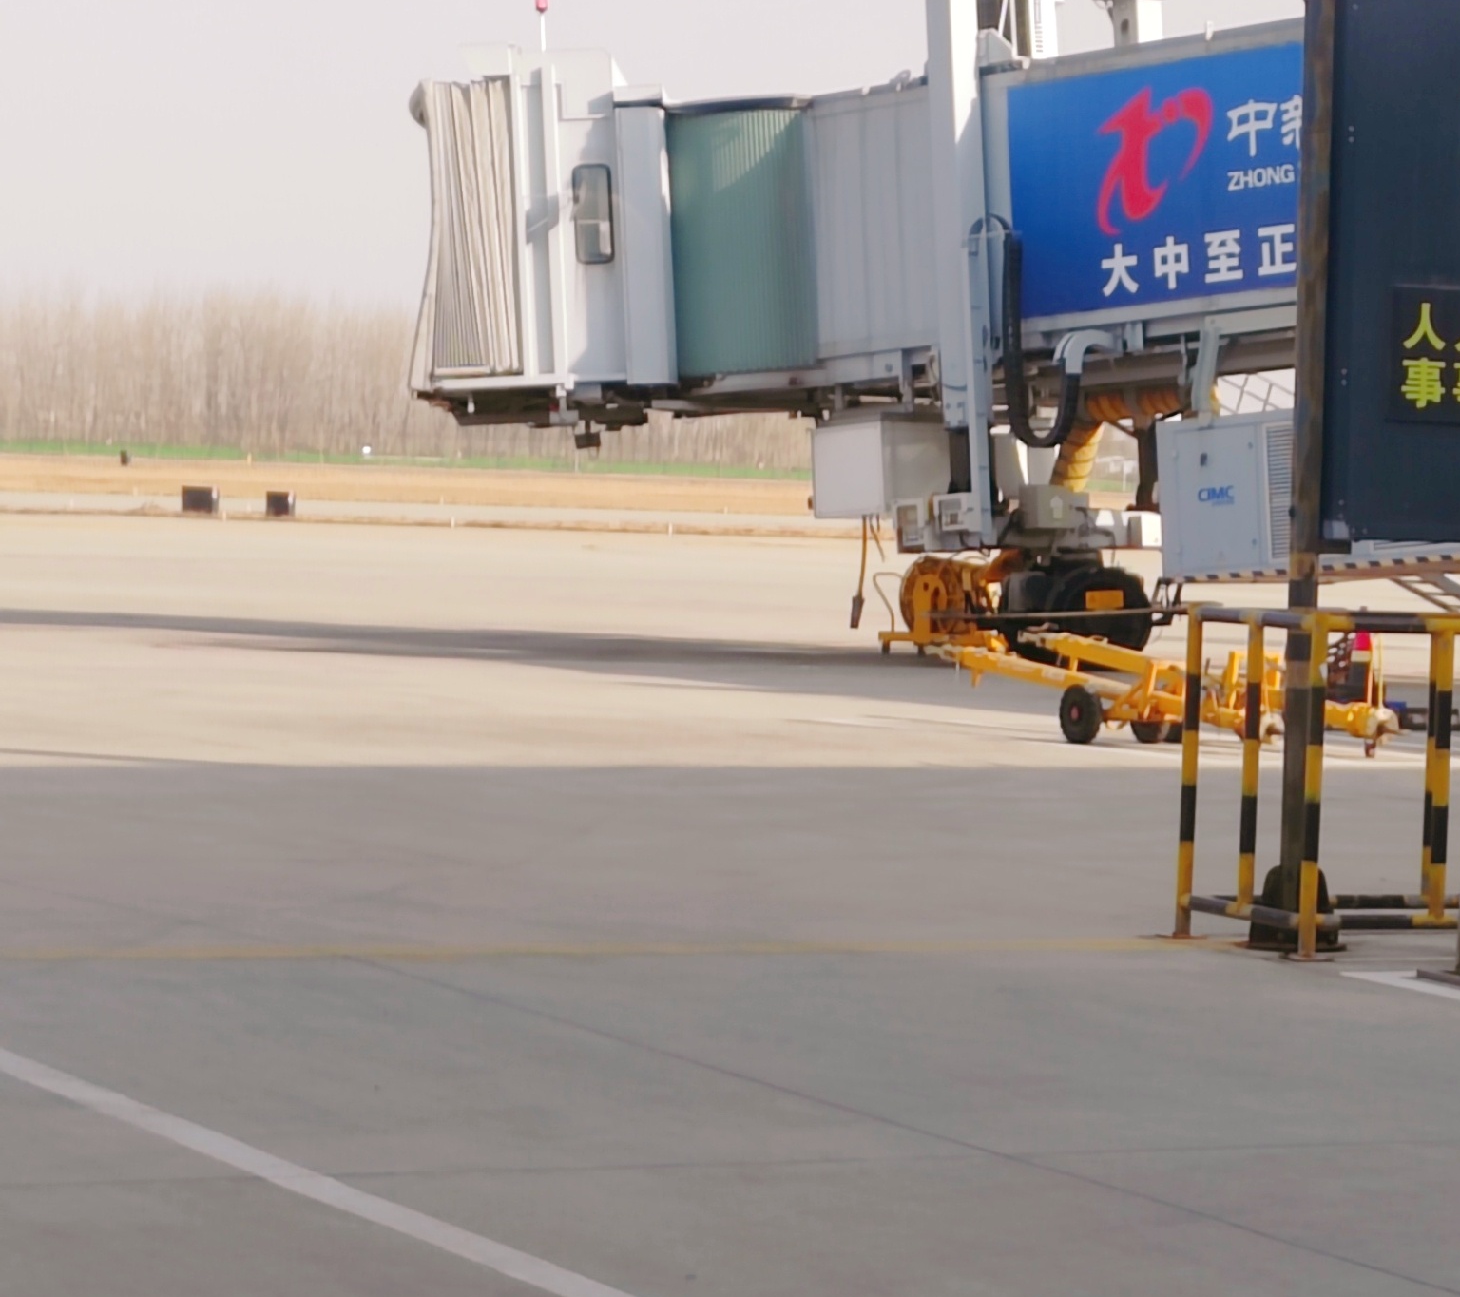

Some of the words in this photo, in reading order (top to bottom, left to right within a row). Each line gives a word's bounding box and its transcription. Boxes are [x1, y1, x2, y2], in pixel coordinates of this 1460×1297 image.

[1227, 164, 1296, 192] ZHONG
[1101, 223, 1297, 298] 大中至正
